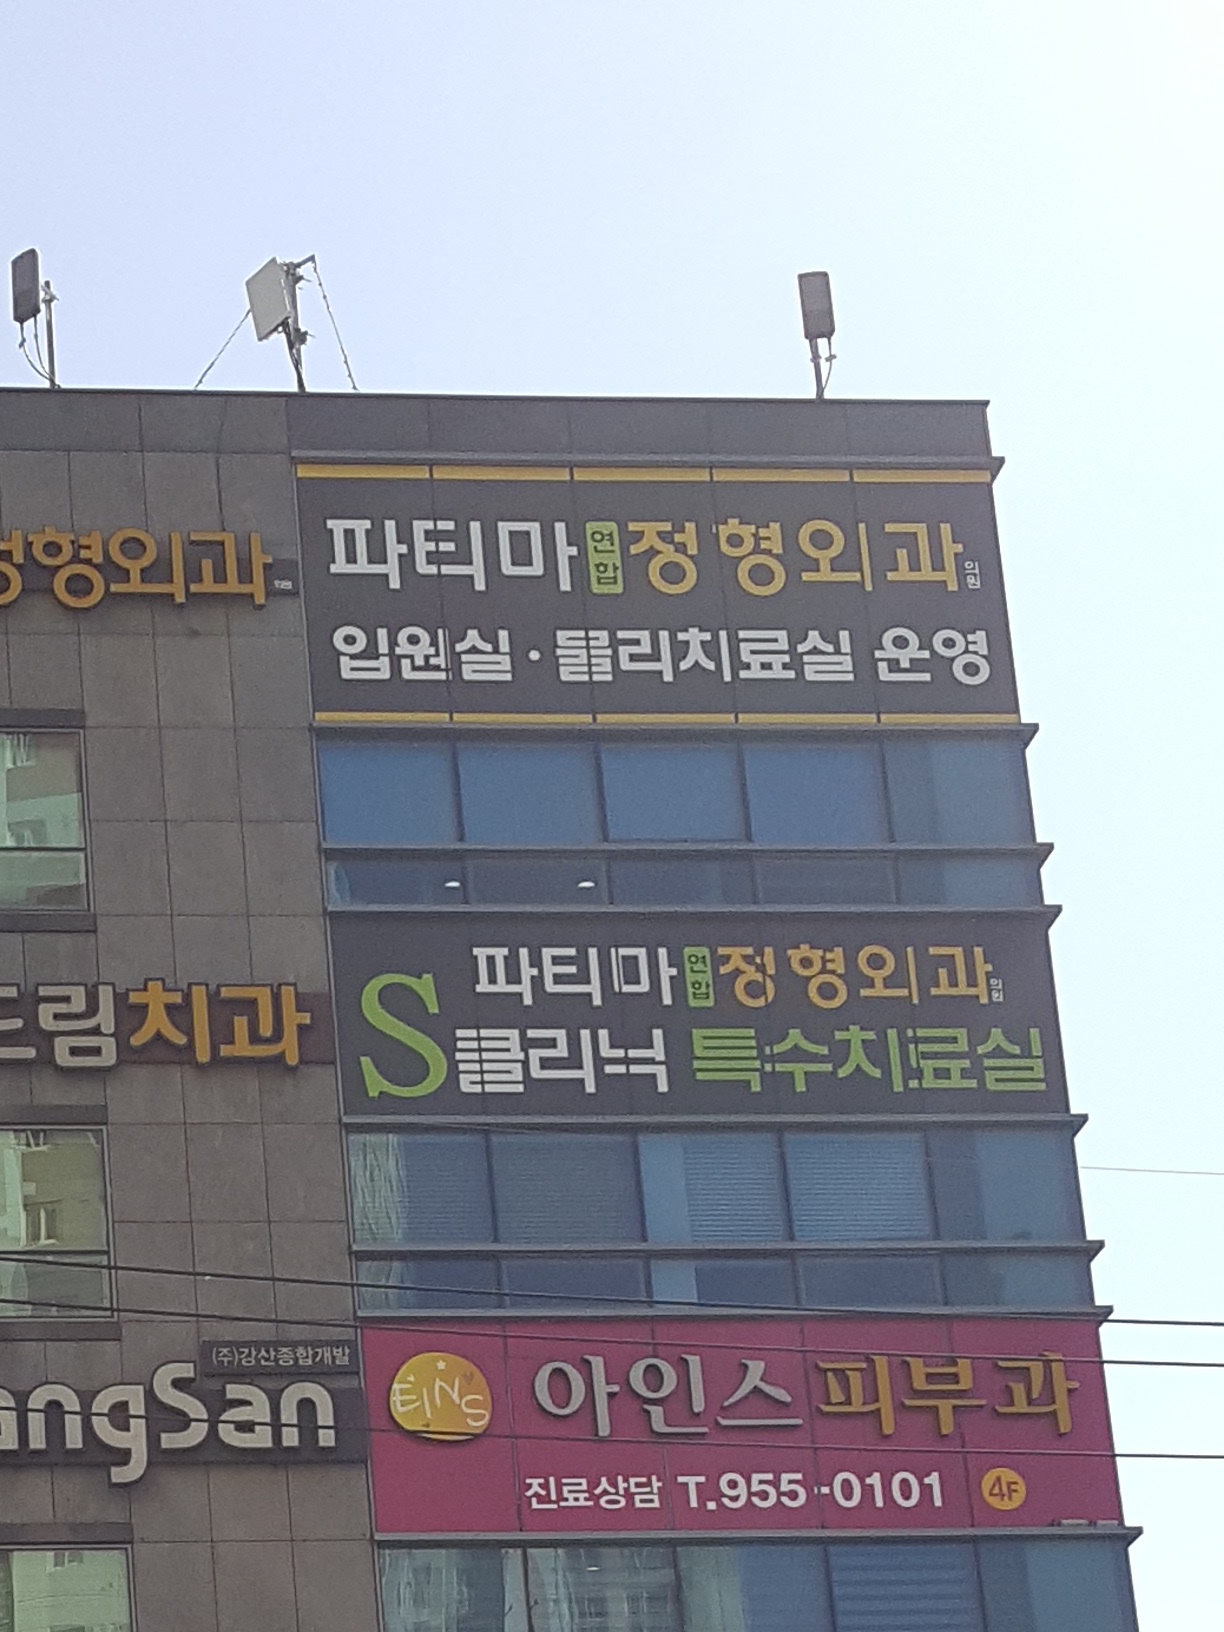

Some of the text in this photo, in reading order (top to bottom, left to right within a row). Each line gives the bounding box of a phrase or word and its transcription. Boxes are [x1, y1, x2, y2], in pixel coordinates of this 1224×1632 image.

[325, 518, 577, 592] 파티마
[626, 517, 964, 596] 정형외과
[875, 626, 991, 686] 운영
[473, 945, 677, 1007] 파티마
[717, 943, 993, 1010] 정형외과
[359, 972, 449, 1099] S
[455, 1026, 1047, 1095] 클리닉 특수치료실
[211, 1345, 351, 1369] (주)강산종합개발
[390, 1369, 492, 1431] EINS
[533, 1351, 1080, 1440] 아인스피부과
[524, 1470, 1020, 1512] 진료상담 T.955-0101 4F
